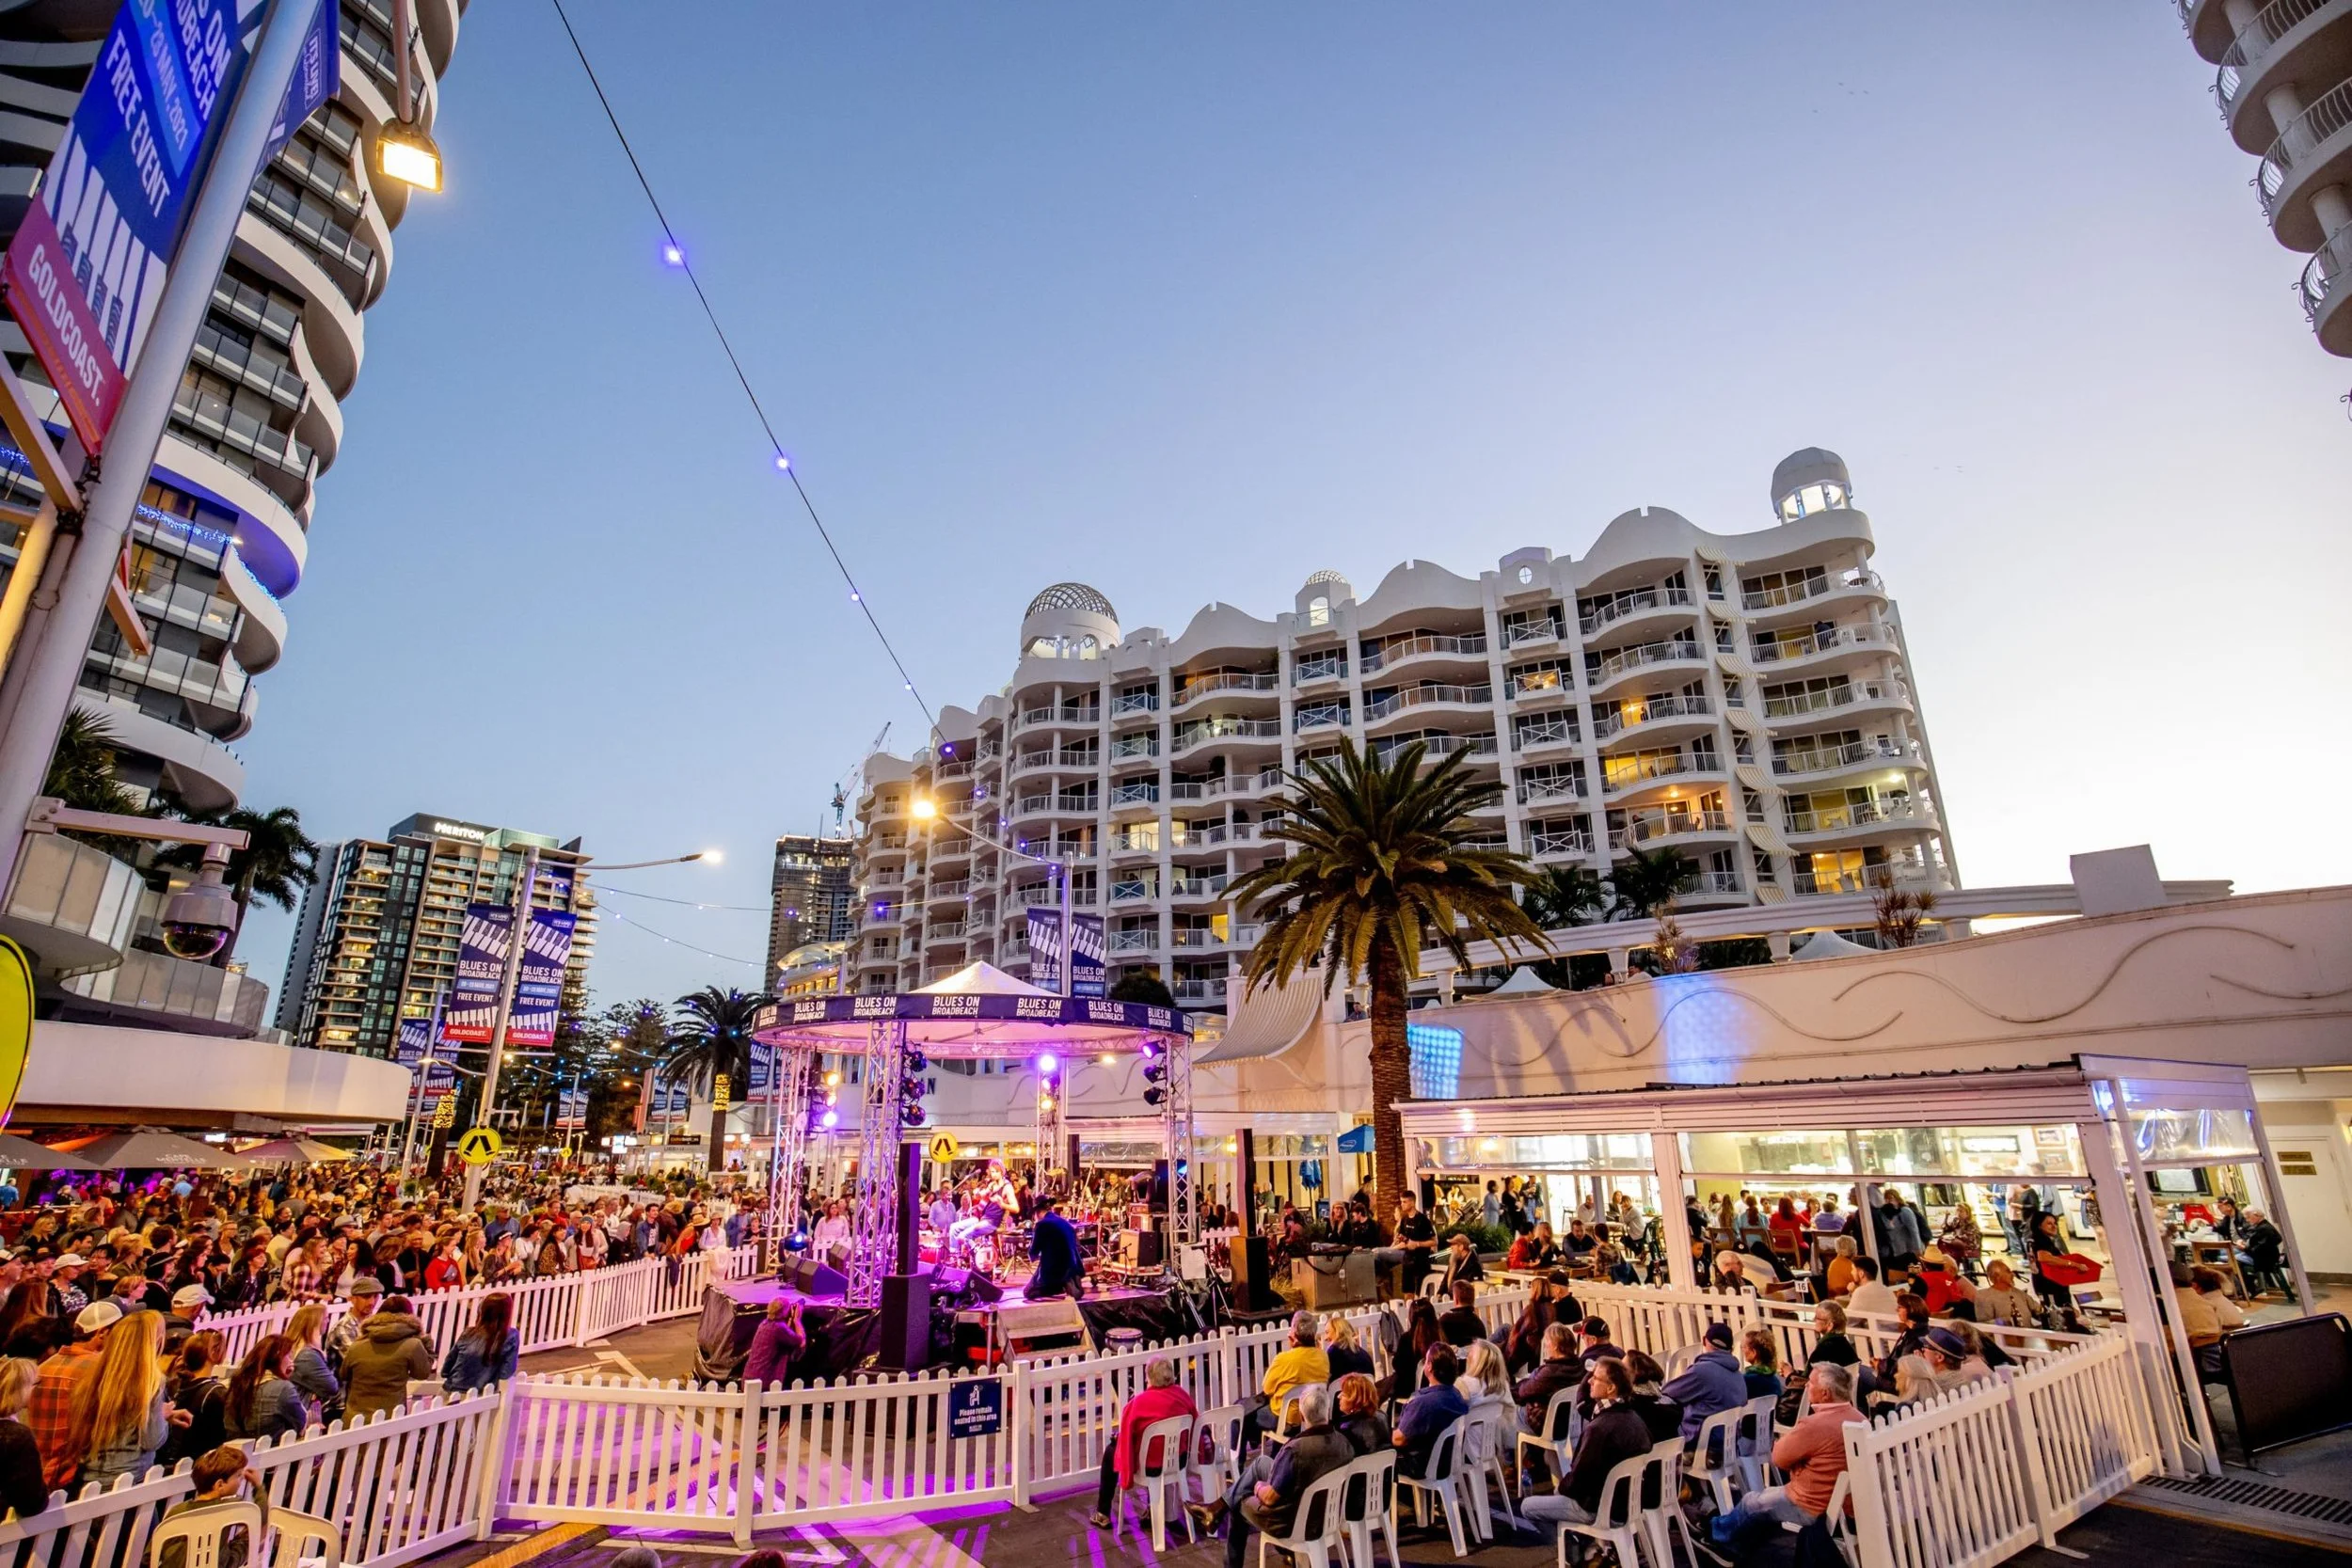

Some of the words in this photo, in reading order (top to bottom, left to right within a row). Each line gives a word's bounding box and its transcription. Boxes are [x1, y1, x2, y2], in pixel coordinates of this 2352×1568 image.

[205, 9, 231, 88] ON
[175, 0, 216, 121] DBEACH
[105, 28, 143, 132] FREE
[131, 109, 170, 218] EVENT
[28, 244, 103, 406] GOLDCOAST.
[434, 821, 485, 840] MERITON
[459, 960, 488, 972] BLUES
[489, 963, 502, 973] ON
[522, 965, 550, 976] BLUES
[551, 968, 564, 978] ON
[1031, 962, 1050, 973] BLUES
[1051, 963, 1060, 973] ON
[1073, 966, 1094, 975] BLUES
[1095, 967, 1105, 975] ON
[458, 970, 501, 980] BROADBEACH
[520, 974, 563, 985] BROADBEACH
[1073, 974, 1105, 982] BROADBEACH
[457, 992, 473, 1001] FREE
[473, 993, 494, 1003] EVENT
[519, 997, 535, 1006] FREE
[534, 999, 556, 1007] EVENT
[854, 997, 882, 1008] BLUES
[883, 996, 898, 1007] ON
[932, 996, 964, 1006] BLUES
[965, 996, 980, 1006] ON
[795, 1002, 816, 1013] BLUES
[816, 1000, 826, 1011] ON
[1017, 998, 1047, 1009] BLUES
[1048, 999, 1062, 1010] ON
[1088, 1001, 1112, 1013] BLUES
[1113, 1003, 1124, 1014] ON
[793, 1010, 825, 1021] BROADBEACH
[853, 1007, 896, 1016] BROADBEACH
[931, 1006, 978, 1016] BROADBEACH
[1016, 1008, 1060, 1018] BROADBEACH
[1089, 1011, 1125, 1022] BROADBEACH
[1148, 1006, 1165, 1019] BLUES
[1165, 1009, 1171, 1021] ON
[449, 1028, 487, 1037] GOLDCOAST.
[969, 1279, 975, 1289] 6
[954, 1417, 971, 1425] seated
[977, 1414, 986, 1422] this
[986, 1413, 997, 1421] area
